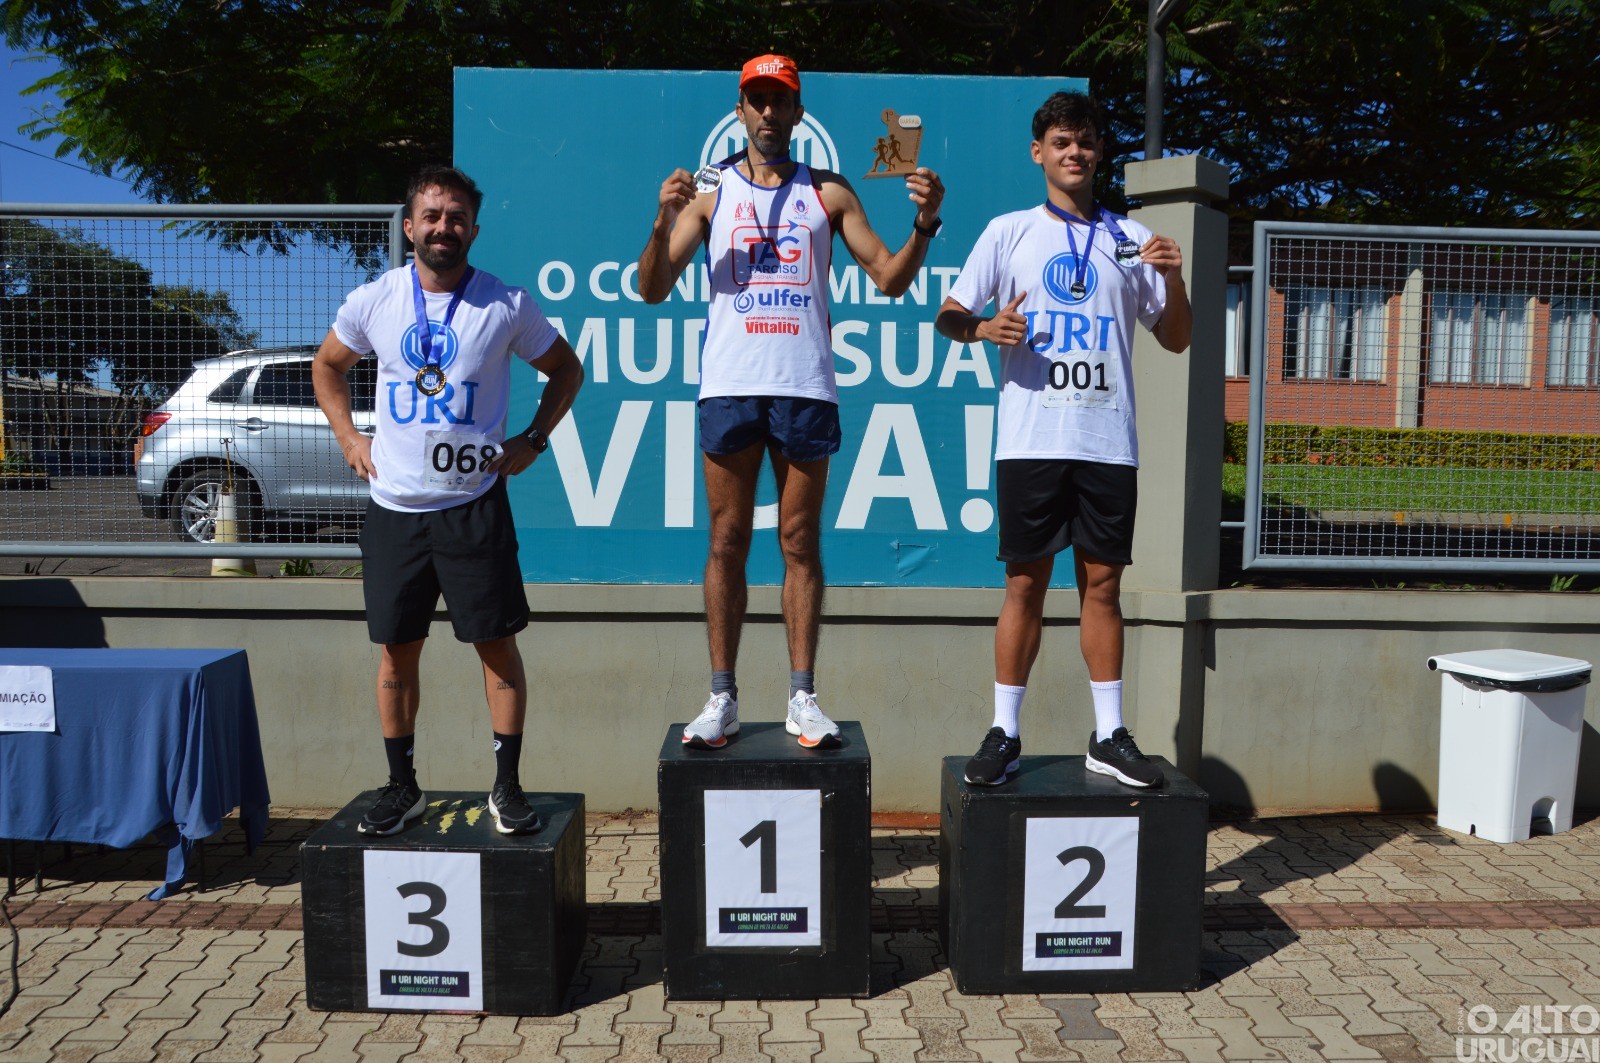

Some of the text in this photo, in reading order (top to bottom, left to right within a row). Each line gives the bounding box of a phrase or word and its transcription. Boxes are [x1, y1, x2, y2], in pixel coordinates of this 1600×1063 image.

[743, 236, 802, 264] TAG
[538, 260, 575, 301] O
[747, 265, 798, 274] TARCISO
[758, 288, 811, 307] ulfer
[745, 321, 800, 335] Vittality
[1023, 310, 1115, 353] URI
[831, 320, 995, 388] SUA
[1049, 361, 1109, 391] 001
[386, 381, 479, 426] URI
[432, 443, 497, 473] 068
[739, 820, 777, 893] 1
[1054, 845, 1106, 919] 2
[396, 881, 450, 957] 3
[737, 912, 750, 921] URI
[752, 912, 778, 921] NIGHT
[780, 912, 797, 921] RUN
[1053, 938, 1066, 946] URI
[1068, 937, 1093, 946] NIGHT
[1095, 937, 1111, 946] RUN
[398, 975, 412, 984] URI
[413, 975, 439, 985] NIGHT
[441, 976, 458, 985] RUN
